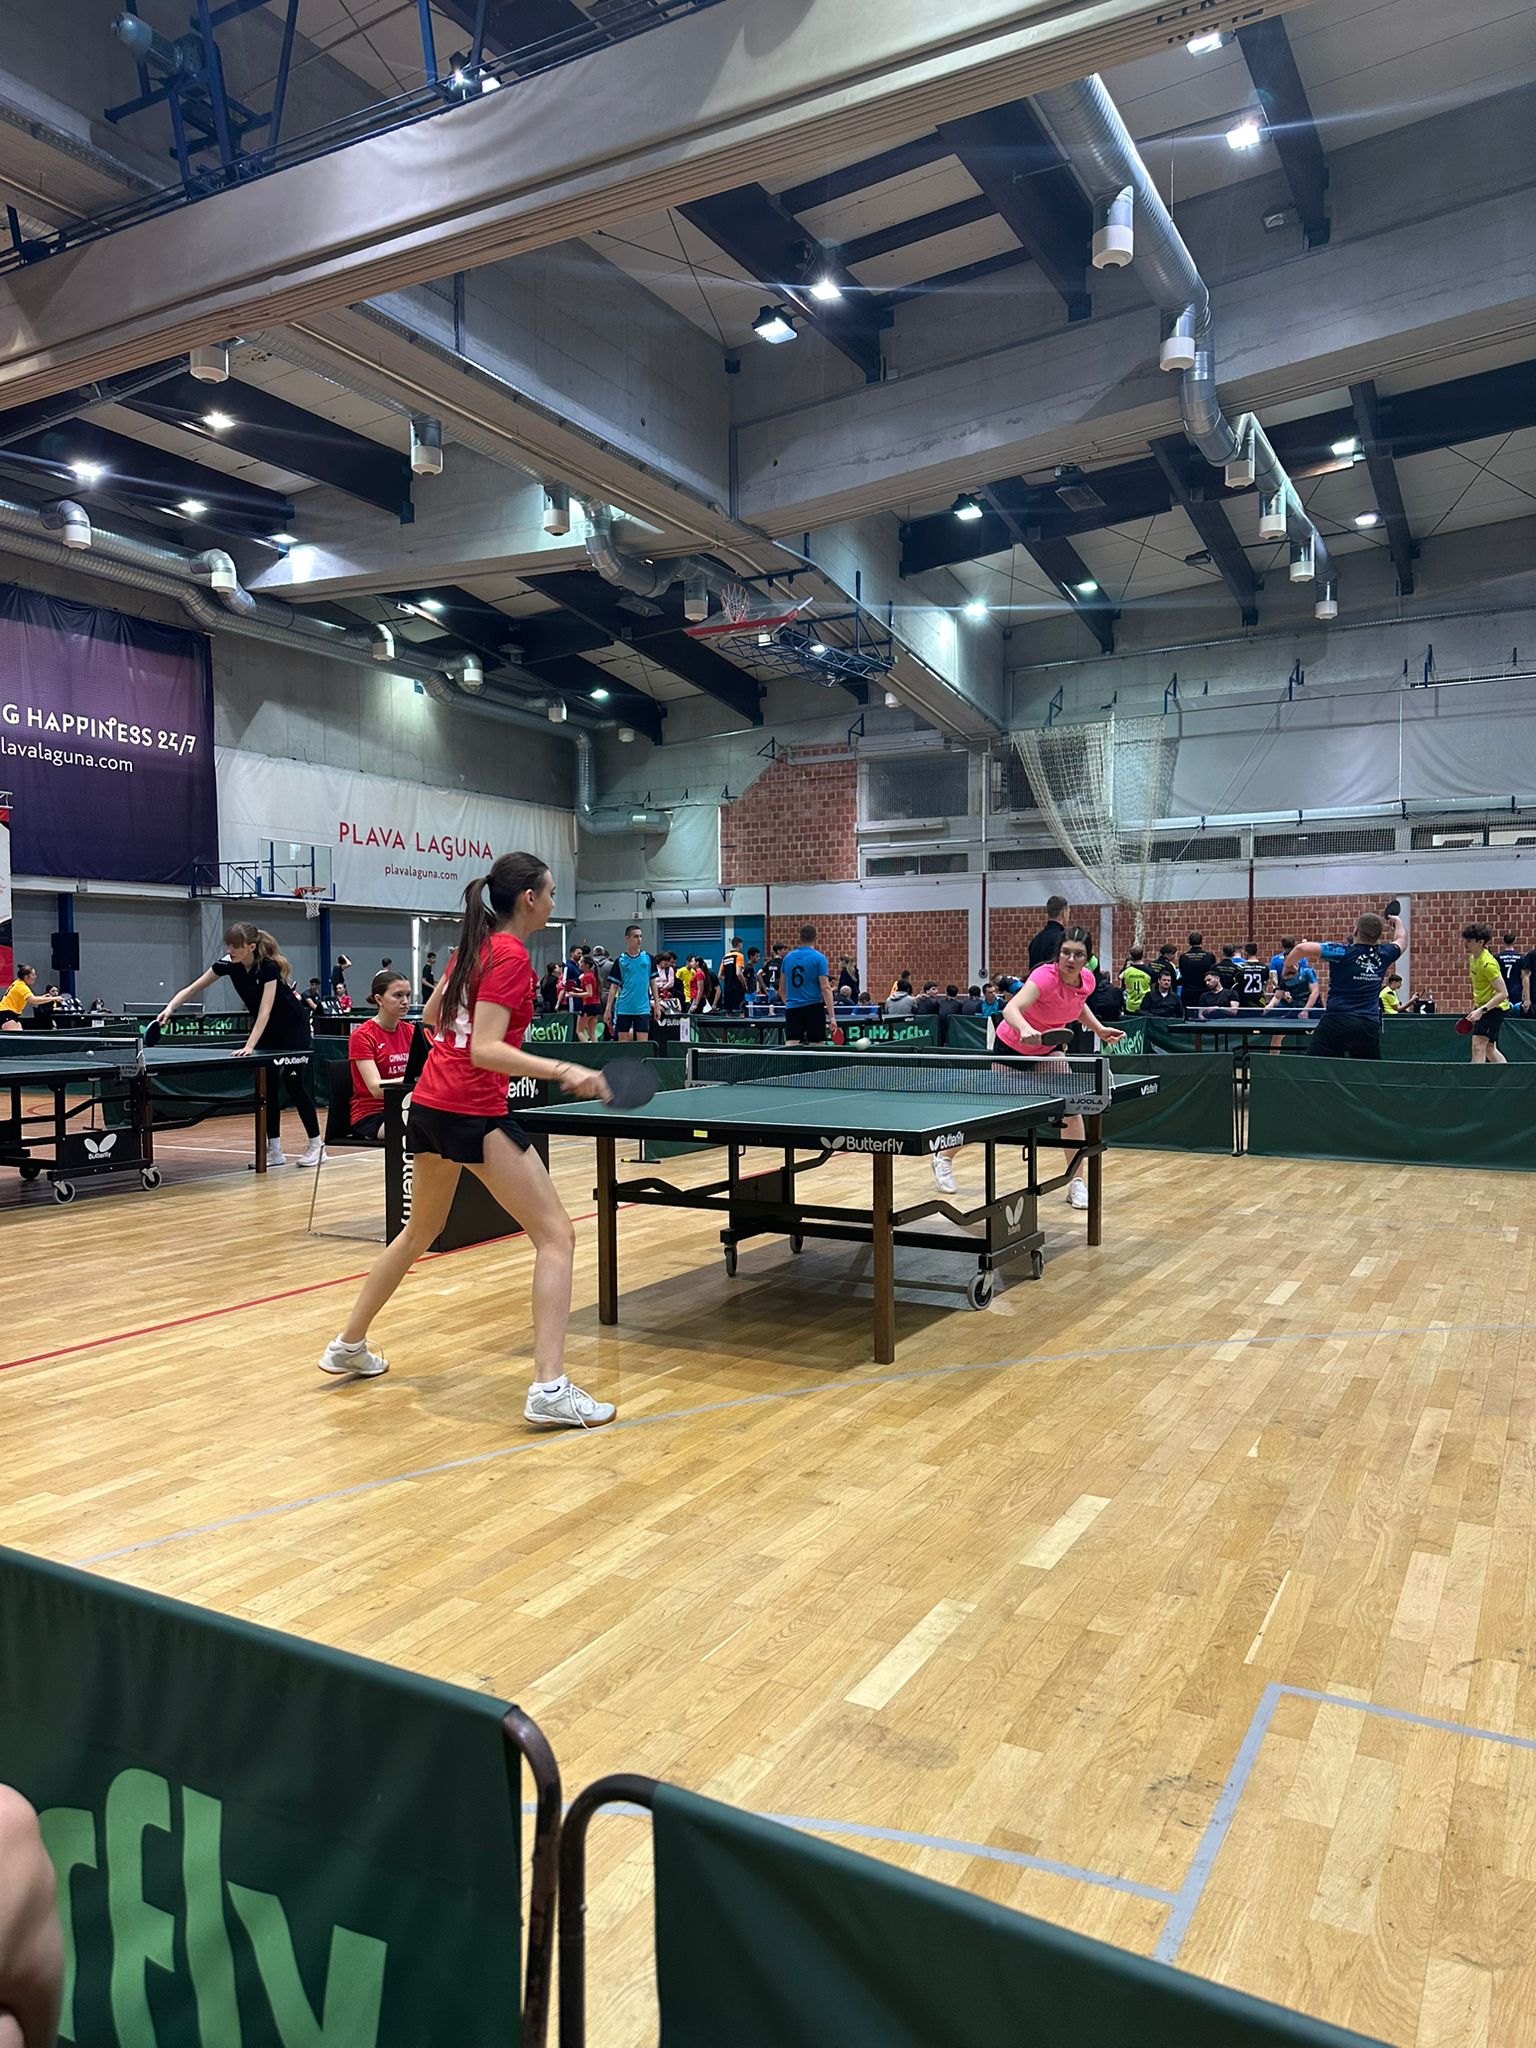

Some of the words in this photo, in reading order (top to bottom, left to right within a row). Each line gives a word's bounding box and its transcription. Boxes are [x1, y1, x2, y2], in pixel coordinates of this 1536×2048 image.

[27, 707, 153, 747] HAPPINESS
[157, 730, 196, 756] 24/7
[339, 822, 406, 850] PLAVA
[416, 832, 493, 861] LAGUNA
[384, 864, 458, 880] plavalaguna.com
[791, 965, 805, 989] 6
[1504, 964, 1513, 979] 7
[1133, 981, 1140, 995] 4
[1243, 973, 1263, 994] 23
[284, 1055, 309, 1066] Butterfly
[846, 1136, 904, 1154] Butterfly
[940, 1130, 965, 1149] Butterfly
[88, 1150, 111, 1160] Butterfly
